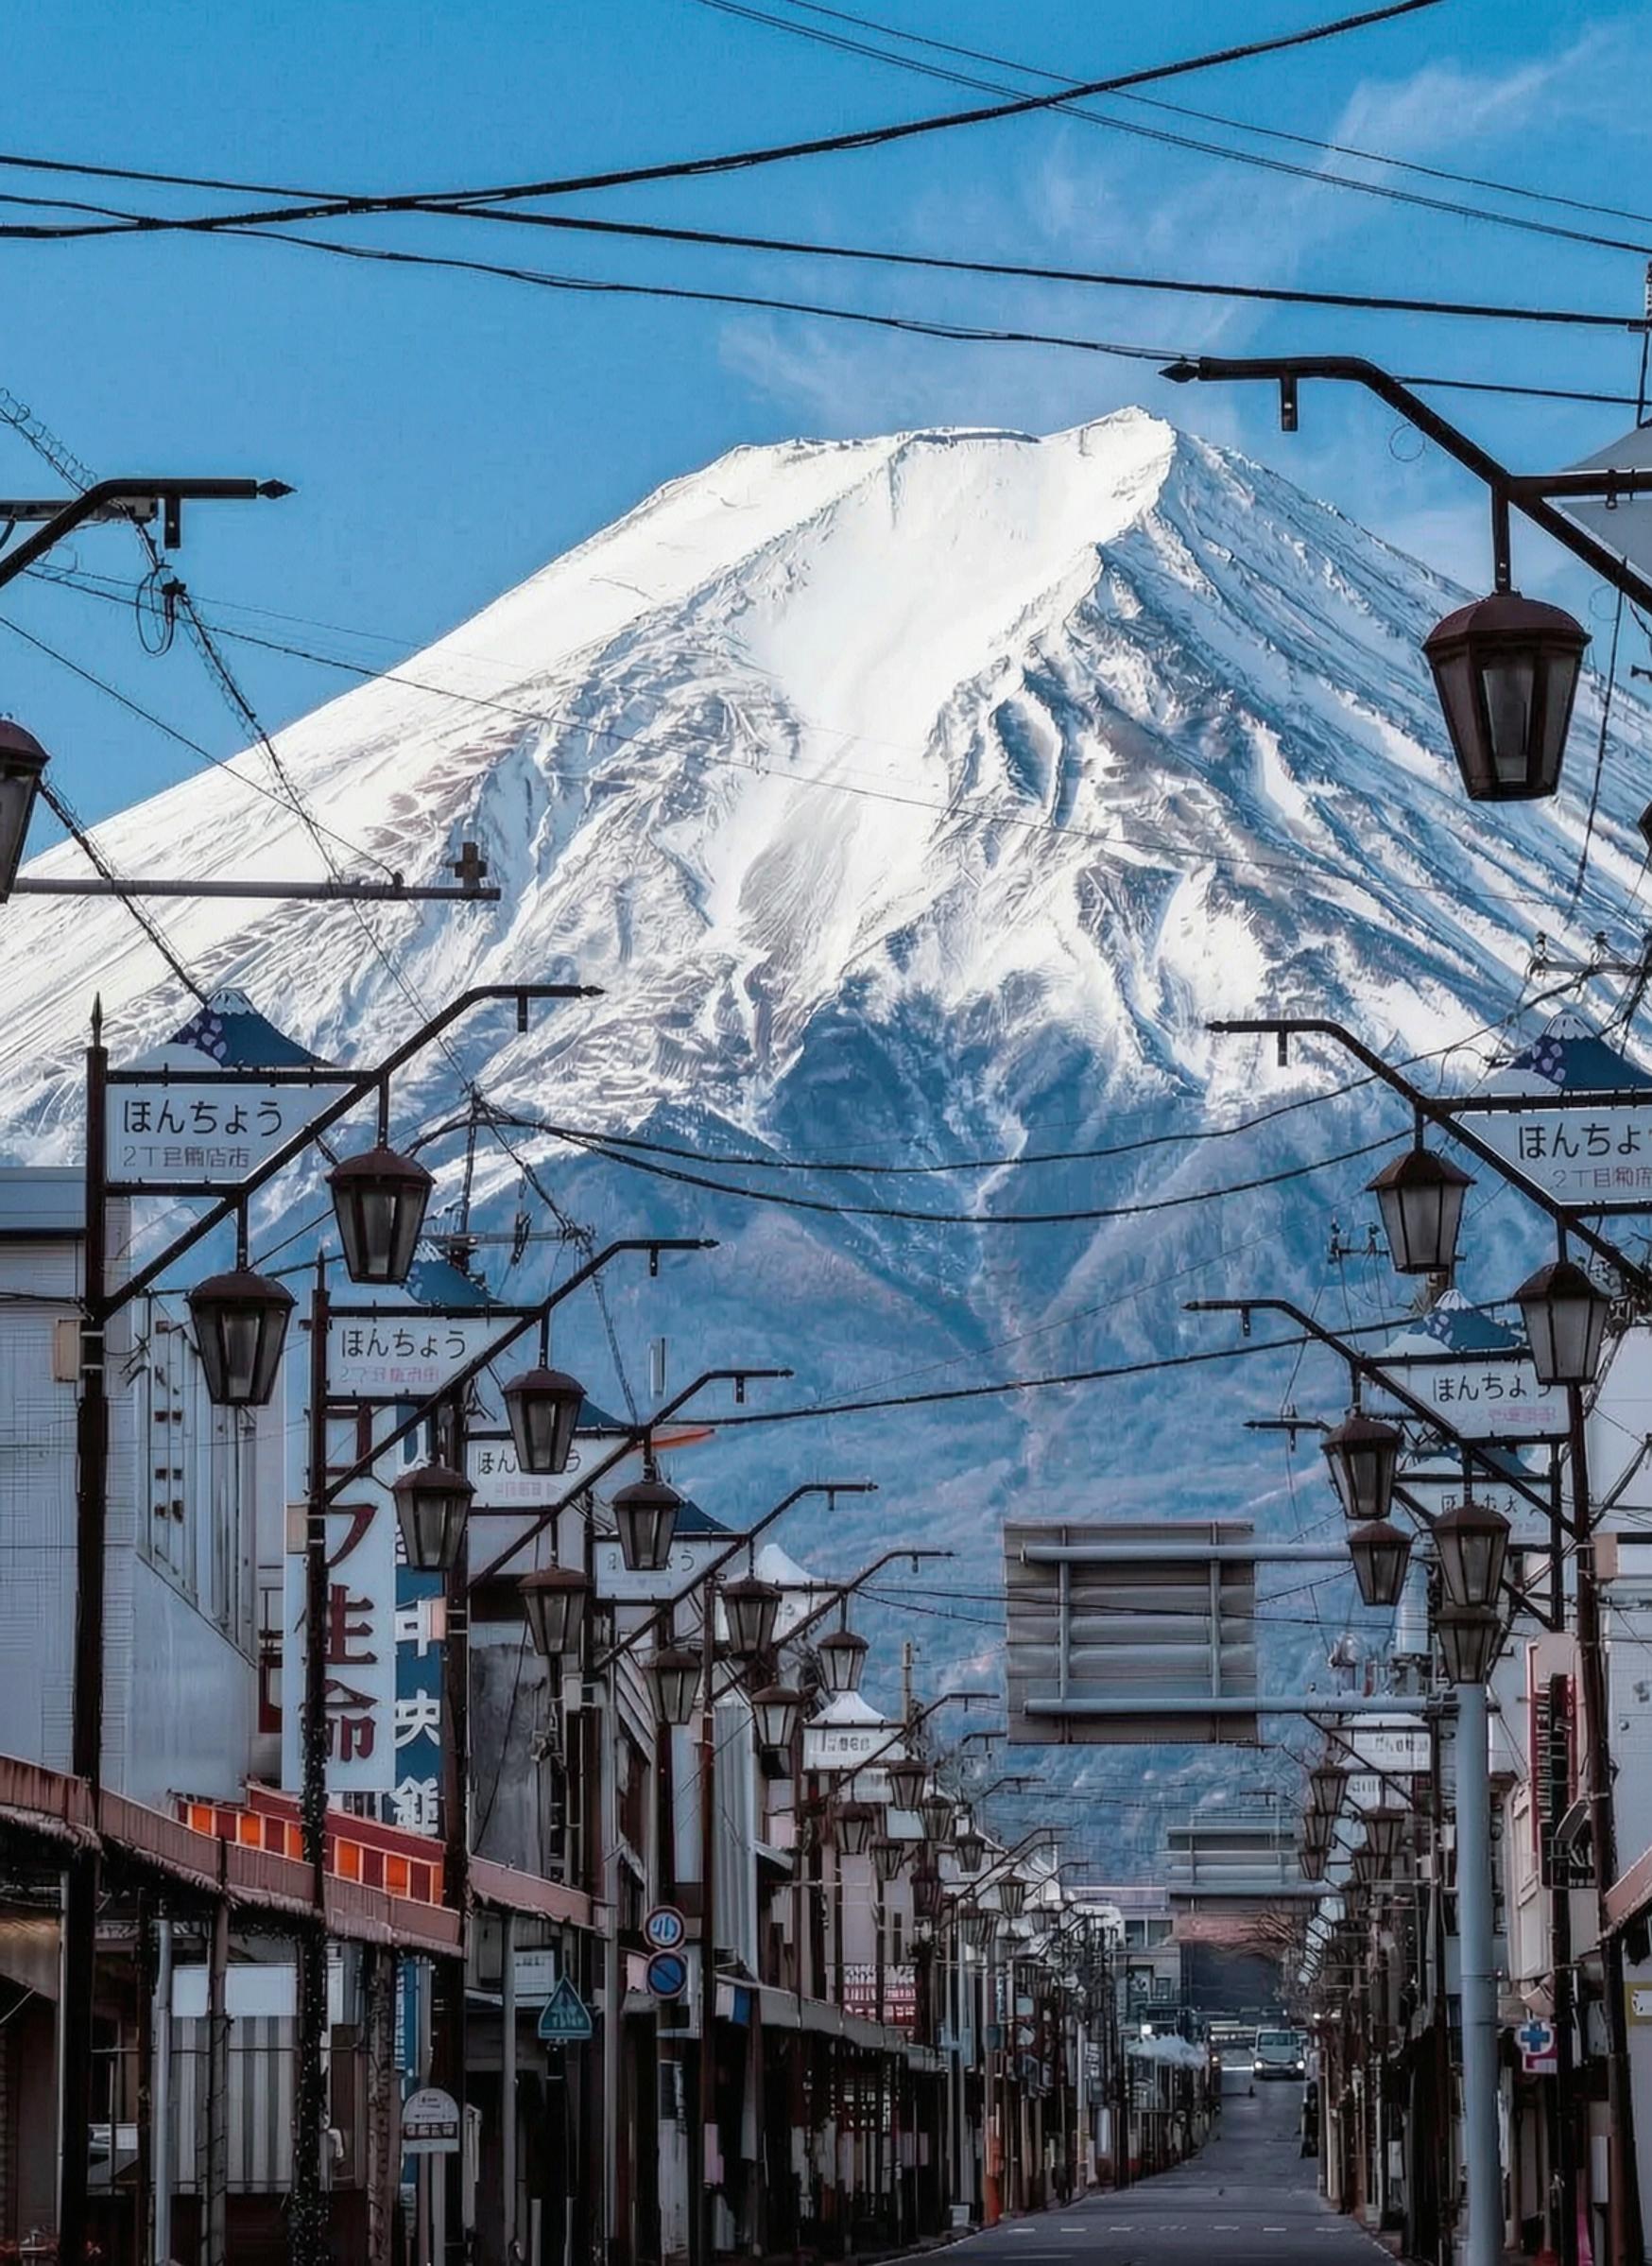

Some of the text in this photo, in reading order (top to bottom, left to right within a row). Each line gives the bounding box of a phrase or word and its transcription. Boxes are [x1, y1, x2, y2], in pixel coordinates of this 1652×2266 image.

[124, 1098, 283, 1137] ほんちょう
[1519, 1121, 1652, 1160] ほんちょ
[341, 1327, 466, 1359] ほんちょう
[477, 1447, 582, 1475] ほんう
